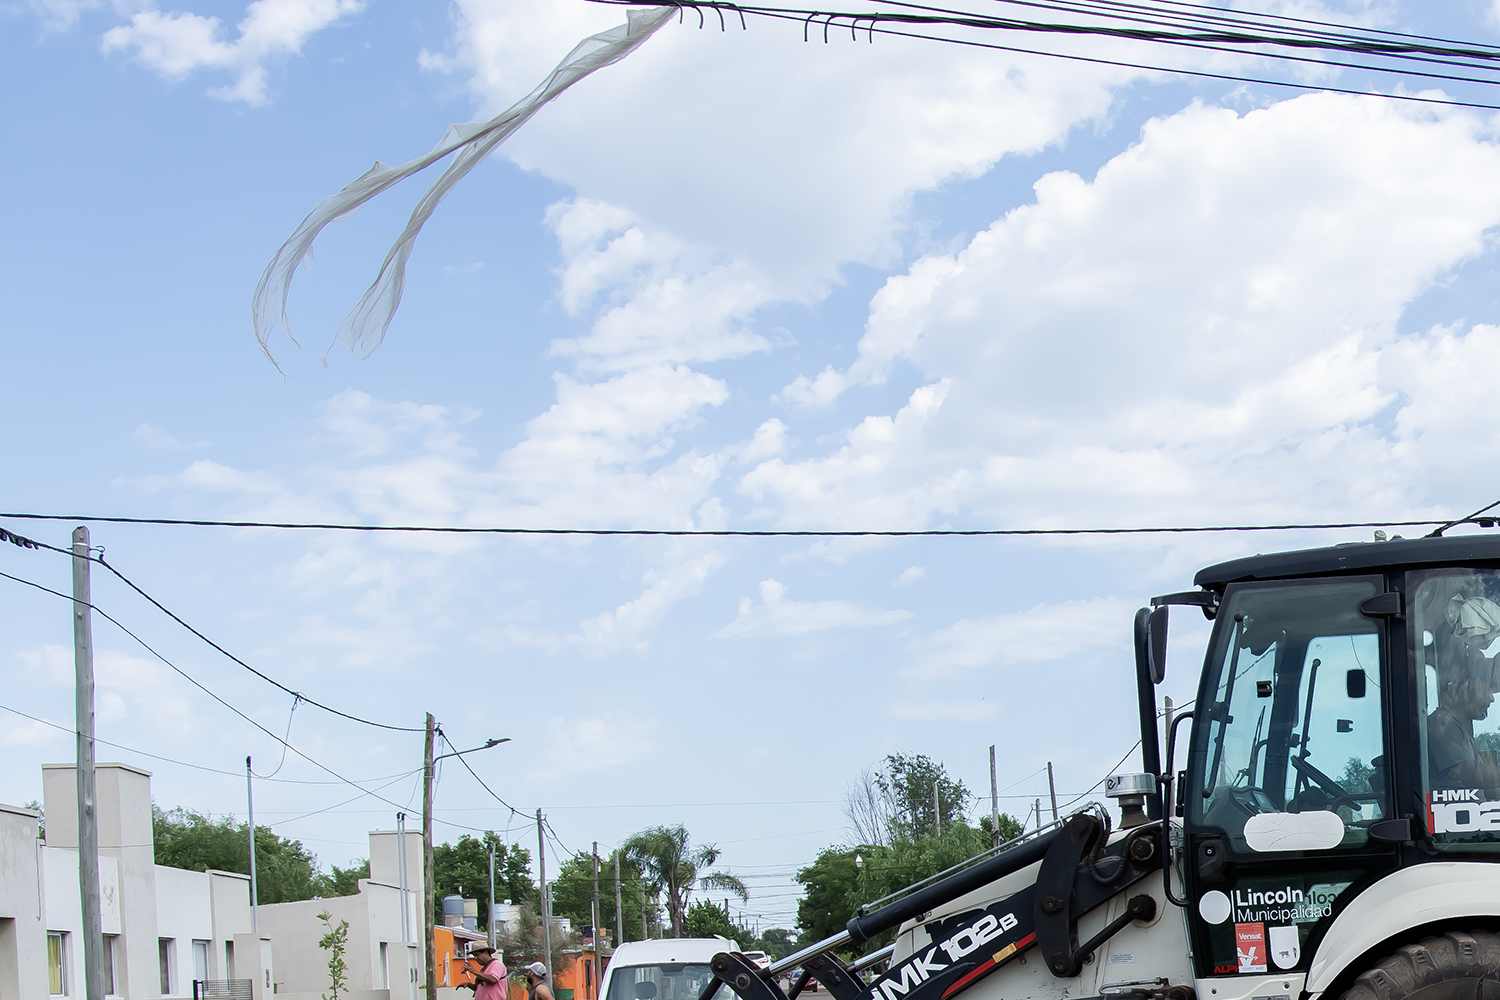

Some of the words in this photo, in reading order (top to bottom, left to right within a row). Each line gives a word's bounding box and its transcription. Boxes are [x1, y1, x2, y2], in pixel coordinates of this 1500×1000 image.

[1432, 789, 1479, 802] HMK
[1236, 886, 1303, 906] Lincoln
[1237, 903, 1332, 923] Municipalidad
[939, 912, 1019, 963] 102B
[1238, 932, 1263, 941] Vensat
